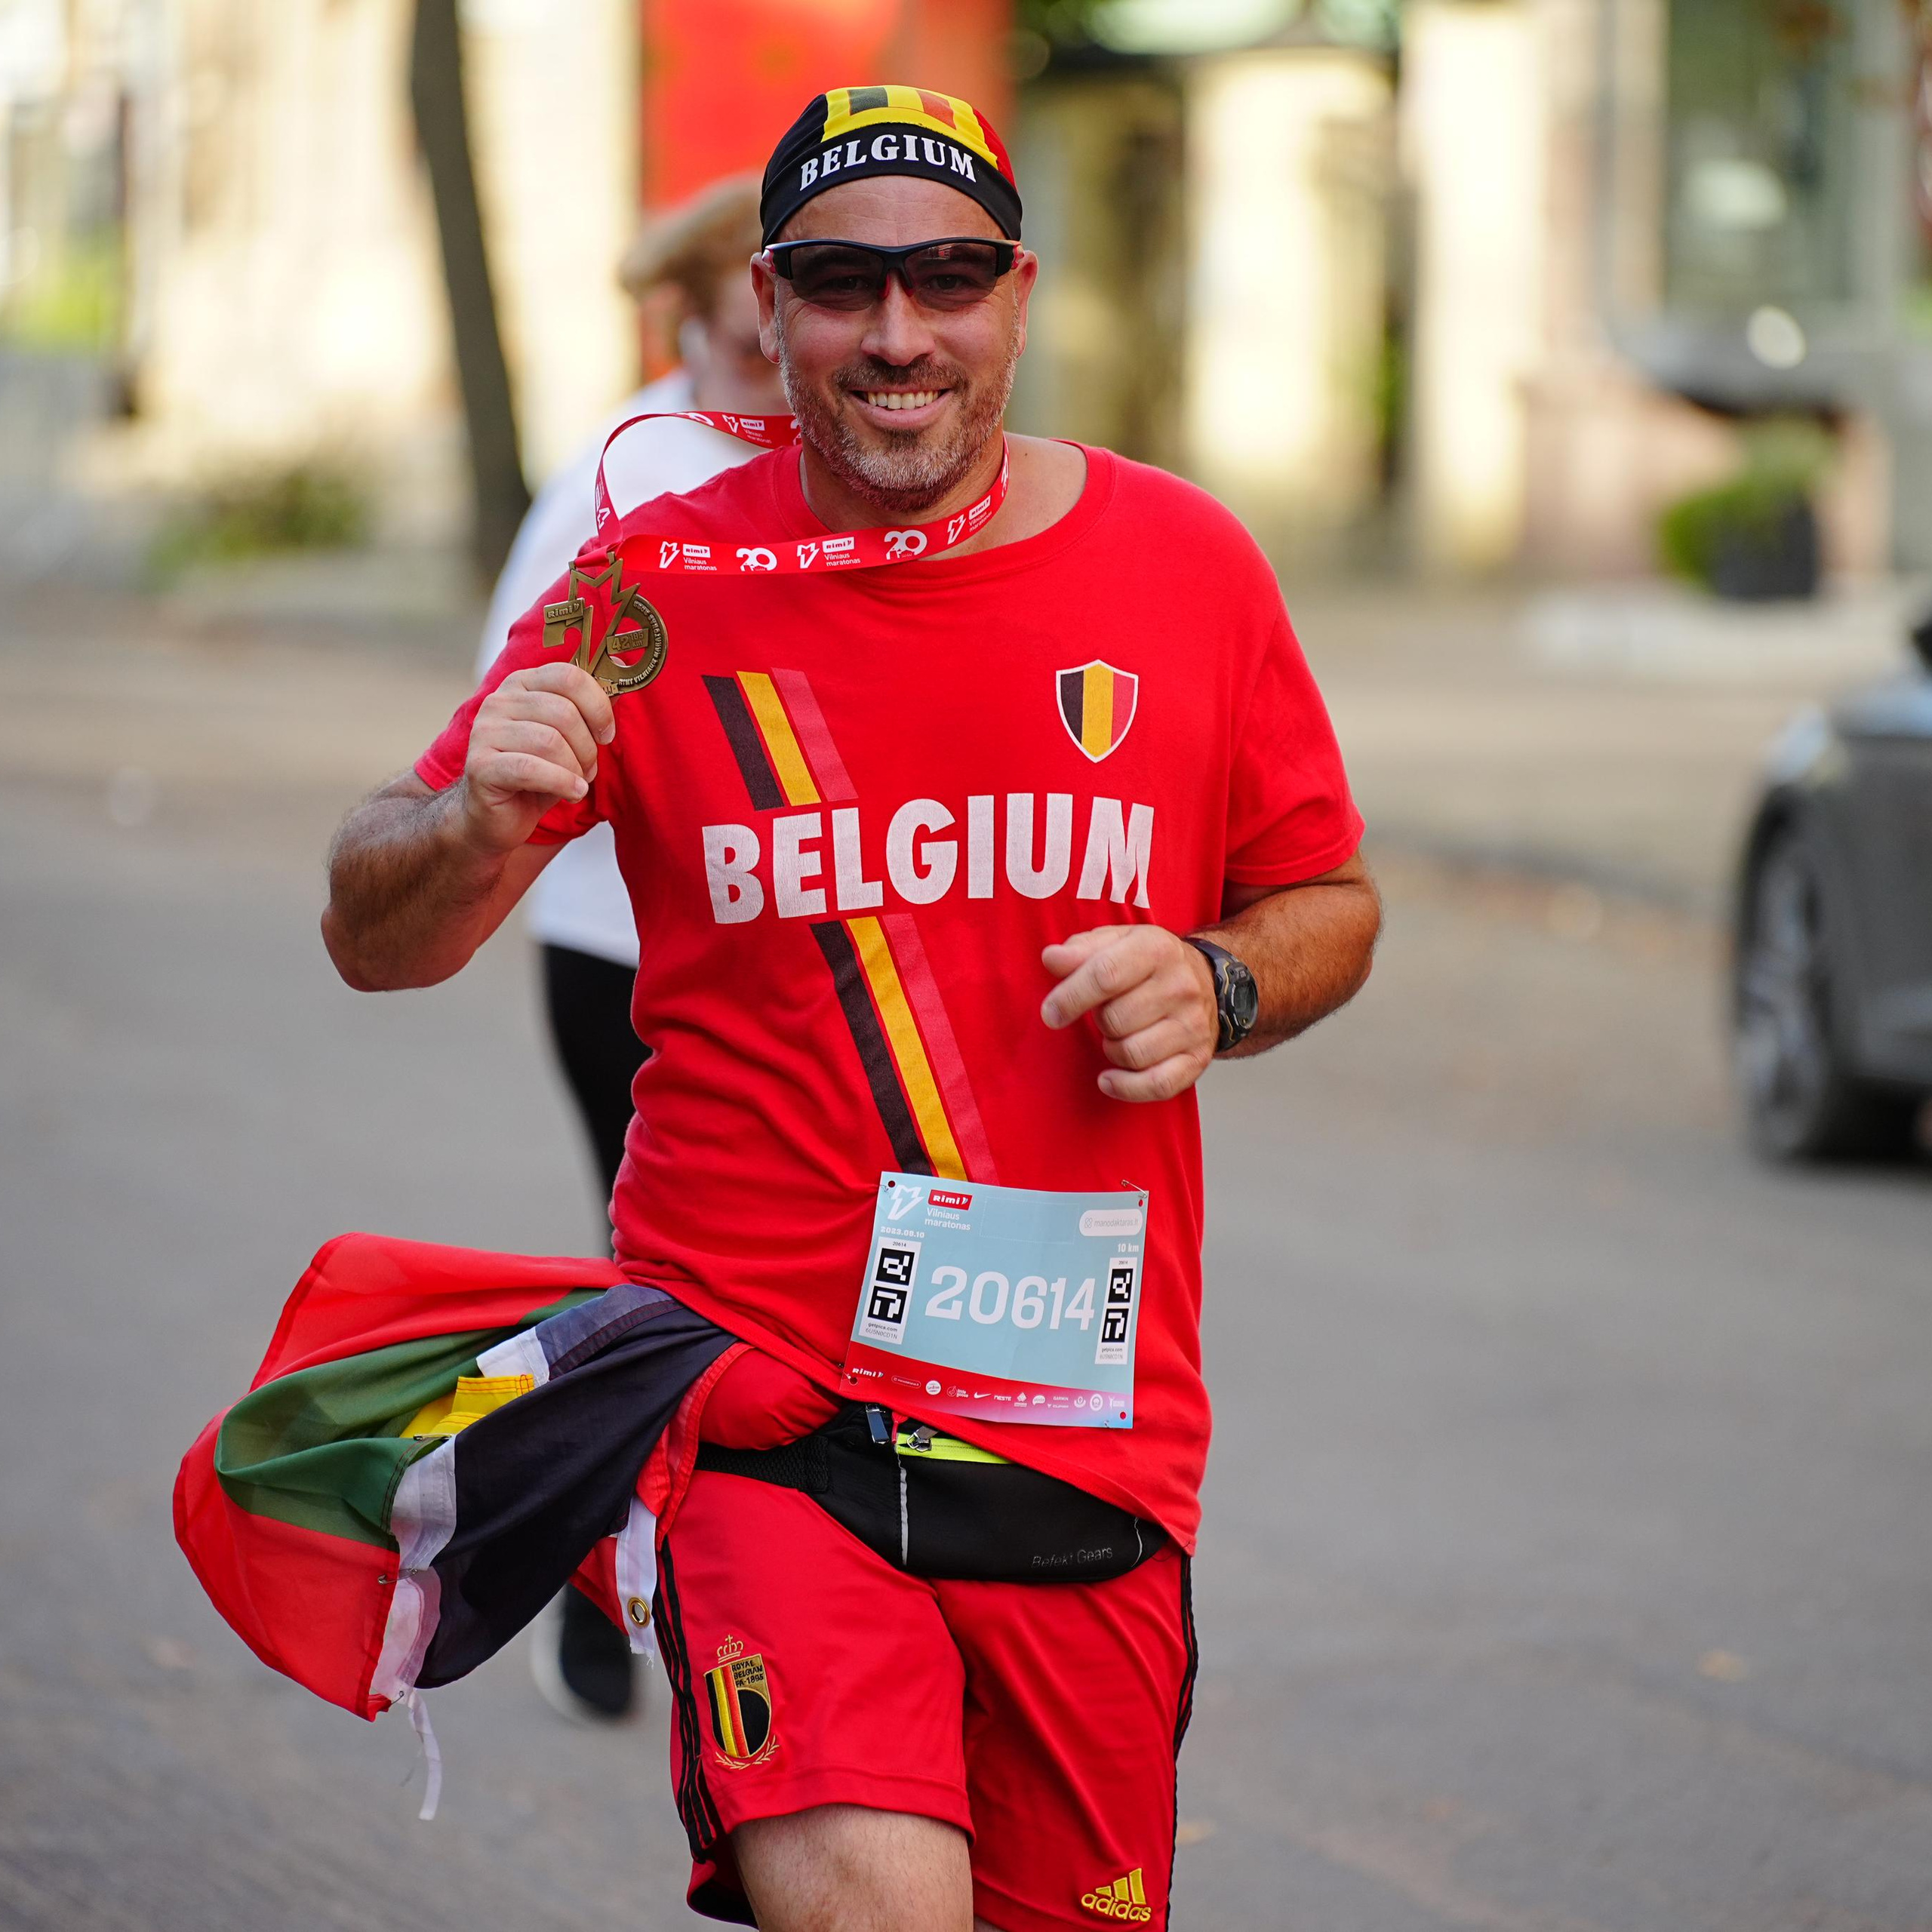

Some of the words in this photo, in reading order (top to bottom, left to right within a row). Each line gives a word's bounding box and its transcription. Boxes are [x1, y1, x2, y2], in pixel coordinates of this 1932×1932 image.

[800, 134, 976, 191] BELGIUM
[826, 540, 846, 549] Rimi
[884, 529, 928, 560] 20
[736, 547, 777, 571] 20
[825, 552, 851, 561] Vilniaus
[826, 558, 861, 567] maratonas
[547, 605, 573, 619] Rimi
[702, 793, 1154, 924] BELGIUM
[933, 1195, 961, 1205] Rimi
[927, 1208, 960, 1220] Vilniaus
[924, 1218, 971, 1231] maratonas
[1117, 1243, 1127, 1253] 10
[1128, 1243, 1140, 1253] km
[925, 1266, 1096, 1331] 20614
[868, 1322, 898, 1332] getpica.com
[852, 1367, 877, 1377] Rimi
[1077, 1547, 1113, 1564] Gears
[732, 1660, 753, 1672] ROYAL
[734, 1665, 763, 1680] BELGIAN
[1081, 1894, 1152, 1922] adidas
